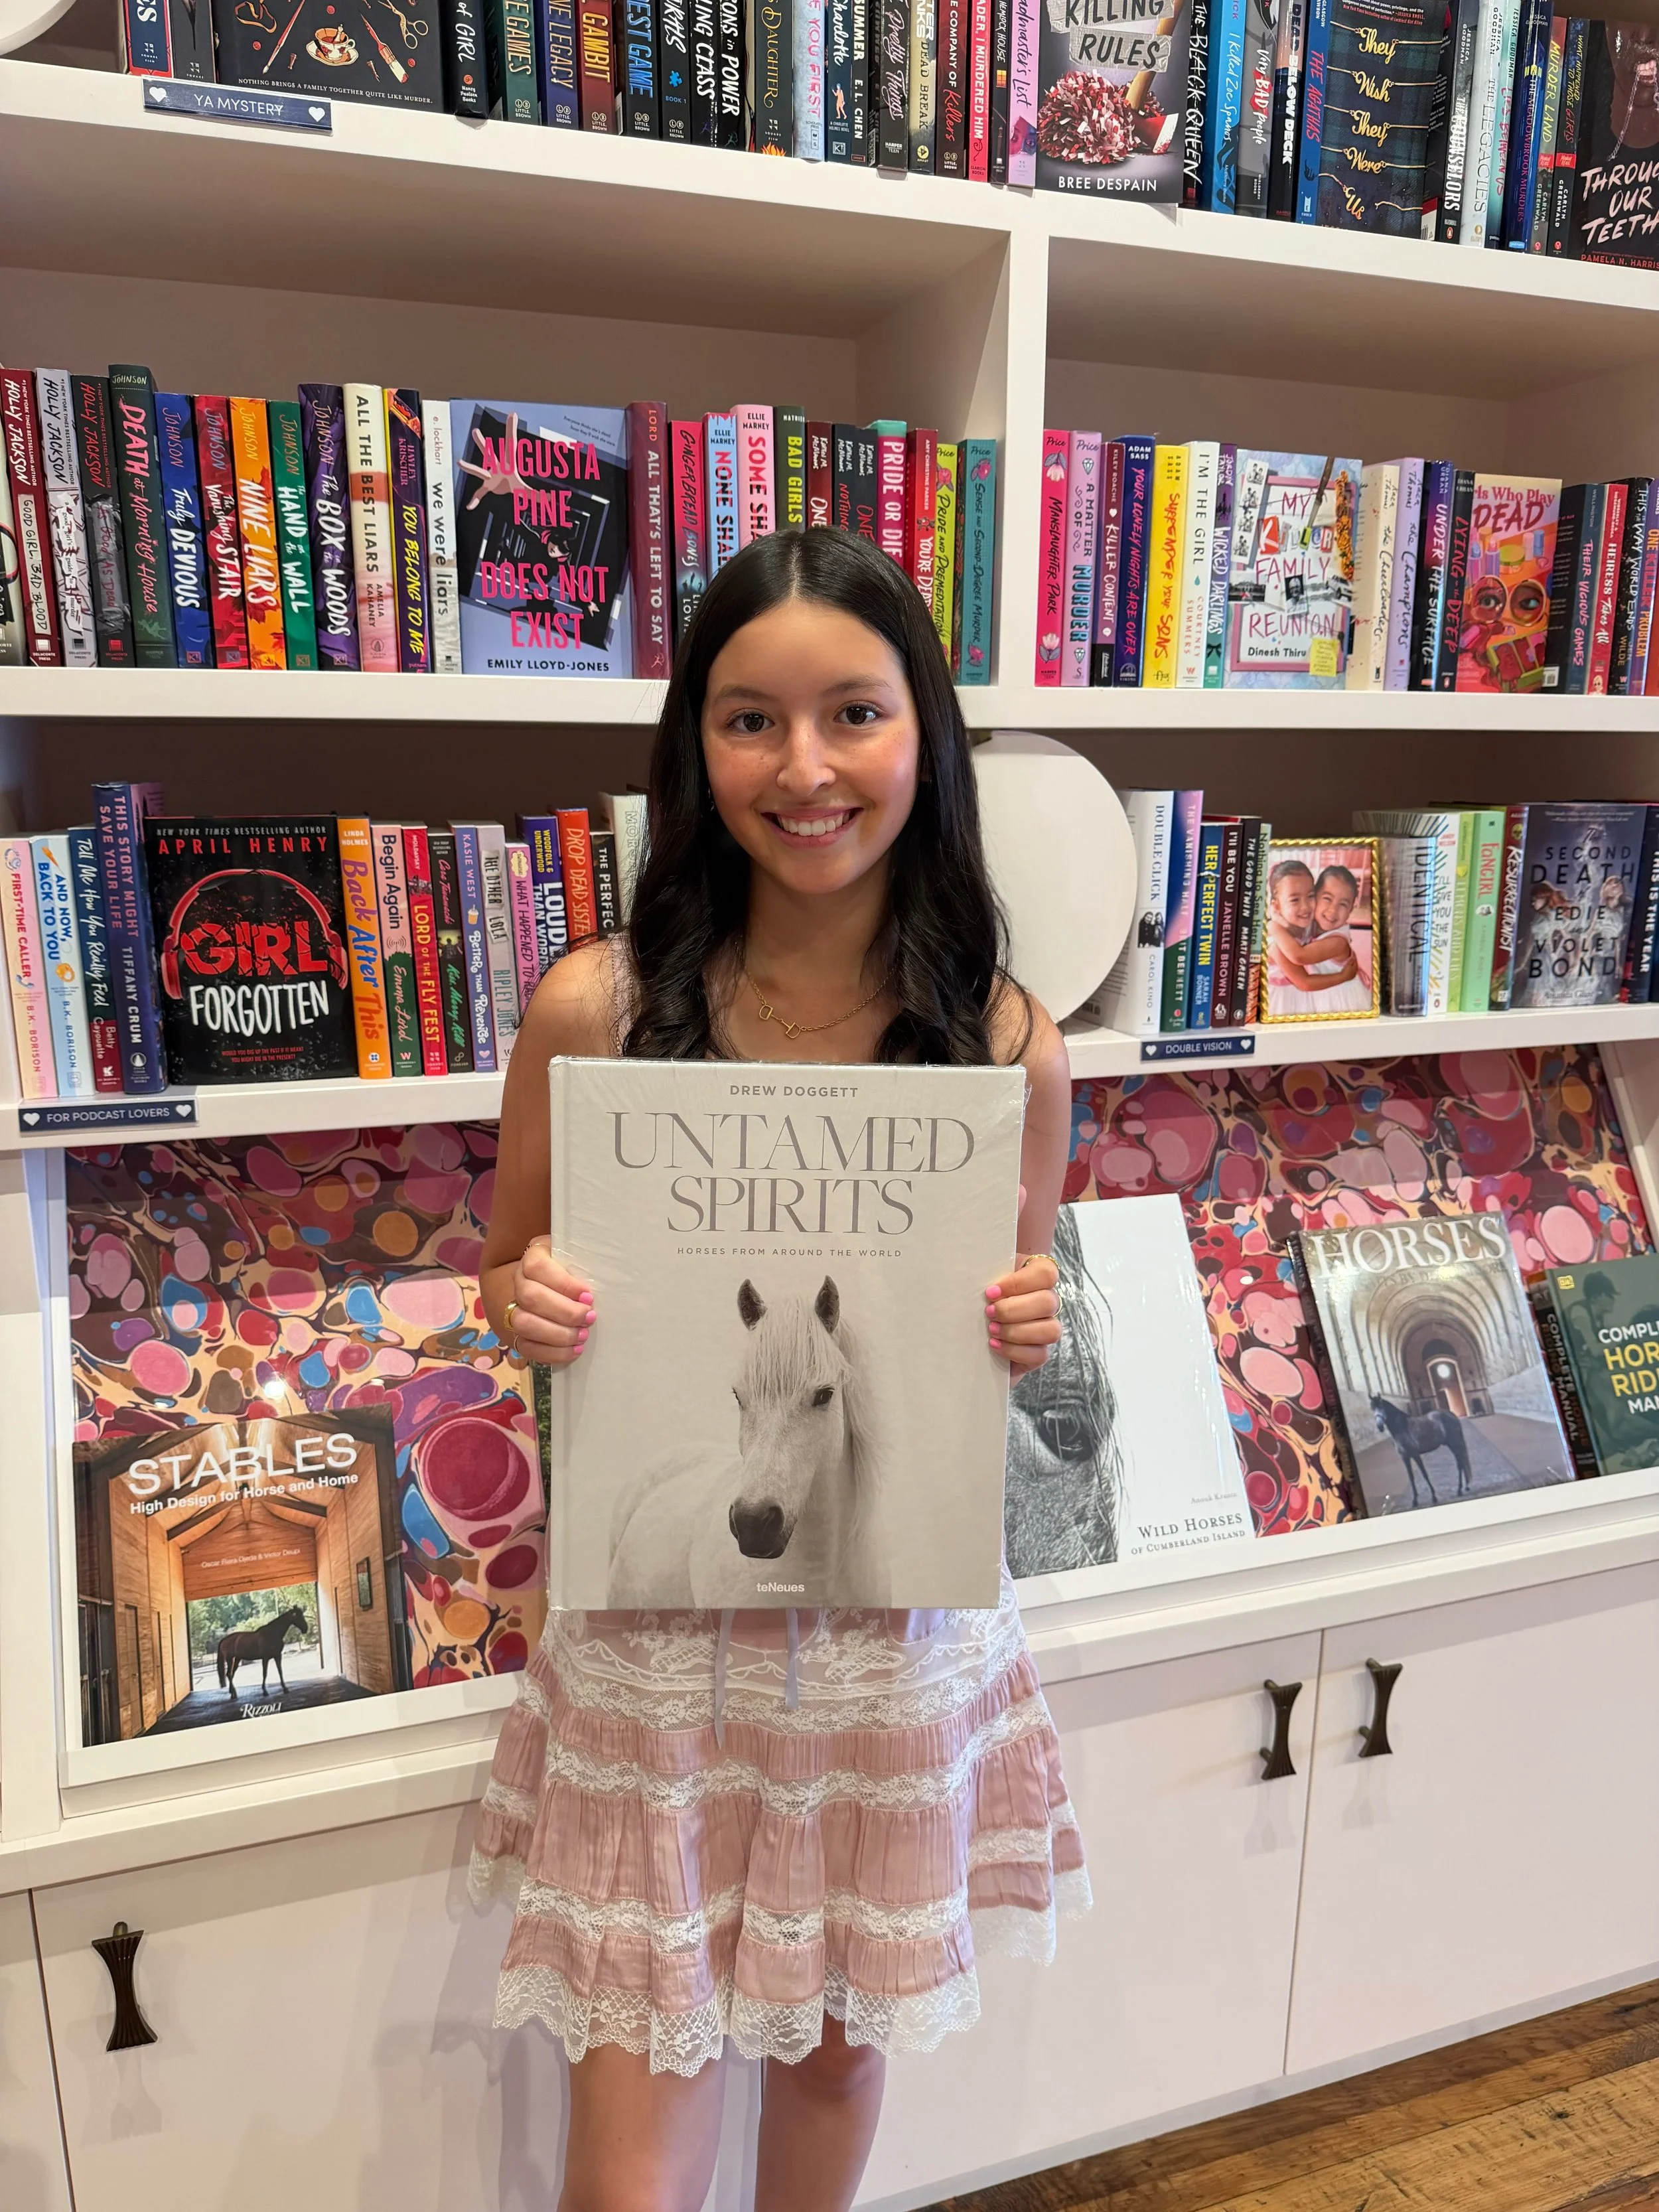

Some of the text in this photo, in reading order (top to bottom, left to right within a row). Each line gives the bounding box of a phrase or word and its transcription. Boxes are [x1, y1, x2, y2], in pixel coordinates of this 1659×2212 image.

[455, 23, 475, 62] GIRL
[506, 15, 531, 75] GAMES
[549, 21, 574, 89] LEGACY
[583, 12, 611, 83] GAMBIT
[1079, 33, 1161, 69] RULES
[1358, 27, 1396, 64] They
[627, 43, 654, 99] GAME
[720, 40, 739, 115] in POWER
[881, 9, 906, 120] Pretty Things
[1283, 5, 1301, 164] DEAD BELOW DECK
[194, 94, 284, 117] YA MYSTERY
[329, 86, 363, 95] TOGETHER
[1183, 3, 1208, 185] THE BLACK QUEEN
[1305, 50, 1324, 142] THE AGATHAS
[1355, 71, 1391, 103] Wish
[1352, 110, 1388, 147] They
[1346, 147, 1383, 173] Were
[1058, 177, 1157, 191] BREE DESPAIN
[1345, 187, 1364, 220] Us
[1609, 186, 1654, 218] OUR
[112, 375, 147, 385] JOHNSON
[5, 378, 31, 485] HOLLY JACKSON
[119, 400, 150, 477] DEATH
[1046, 436, 1066, 447] Price
[482, 437, 601, 480] AUGUSTA
[787, 437, 803, 523] BAD GIRLS
[356, 396, 379, 572] ALL THE BEST LIARS
[1281, 491, 1311, 520] MY
[131, 493, 156, 563] Morning
[512, 488, 573, 528] PINE
[1193, 453, 1210, 565] I'M THE GIRL
[1473, 502, 1544, 532] DEAD
[167, 488, 200, 609] Truly DEVIOUS
[238, 478, 278, 606] NINE LIARS
[433, 482, 453, 617] we were liars
[648, 451, 662, 644] ALL THAT'S LEFT TO SAY
[23, 499, 47, 630] GOOD GIRL, BAD BLOOD
[401, 505, 425, 656] YOU BELONG TO ME
[480, 561, 609, 603] DOES NOT
[1256, 557, 1331, 584] FAMILY
[136, 564, 159, 614] House
[510, 611, 584, 650] EXIST
[1250, 613, 1336, 638] REUNION
[488, 660, 609, 672] EMILY LLOYD-JONES
[1248, 647, 1306, 658] Dinesh Thiru
[100, 806, 122, 929] SAVE YOUR LIFE
[113, 796, 139, 938] THIS STORY MIGHT
[159, 837, 328, 855] APRIL HENRY
[1546, 846, 1632, 860] SECOND
[380, 834, 403, 930] Begin Again
[1530, 863, 1634, 885] DEATH
[12, 873, 27, 933] FIRST-TIME
[38, 863, 59, 960] BACK TO YOU
[55, 874, 74, 942] AND NOW,
[414, 905, 430, 944] LORD
[1198, 846, 1218, 966] HER PERFECT TWIN
[1554, 905, 1606, 919] EDIE
[18, 936, 31, 978] CALLER
[180, 921, 328, 977] GIRL
[342, 859, 381, 1040] Back After This
[1535, 937, 1619, 952] VIOLET
[1528, 957, 1618, 979] BOND
[121, 948, 142, 1043] TIFFANY CRUM
[190, 981, 329, 1037] FORGOTTEN
[421, 980, 436, 1005] FLY
[424, 1009, 441, 1043] FEST
[1166, 1042, 1232, 1053] DOUBLE VISION
[730, 1084, 859, 1097] DREW DOGGETT
[46, 1108, 170, 1123] FOR PODCAST LOVERS
[607, 1112, 975, 1173] UNTAMED
[667, 1176, 914, 1235] SPIRITS
[1309, 1217, 1507, 1278] HORSES
[127, 1433, 358, 1496] STABLES
[130, 1473, 358, 1516] High Design for Horse and Home
[1184, 1512, 1242, 1532] HORSES
[1146, 1536, 1209, 1552] CUMBERLAND
[757, 1582, 805, 1593] teNeues
